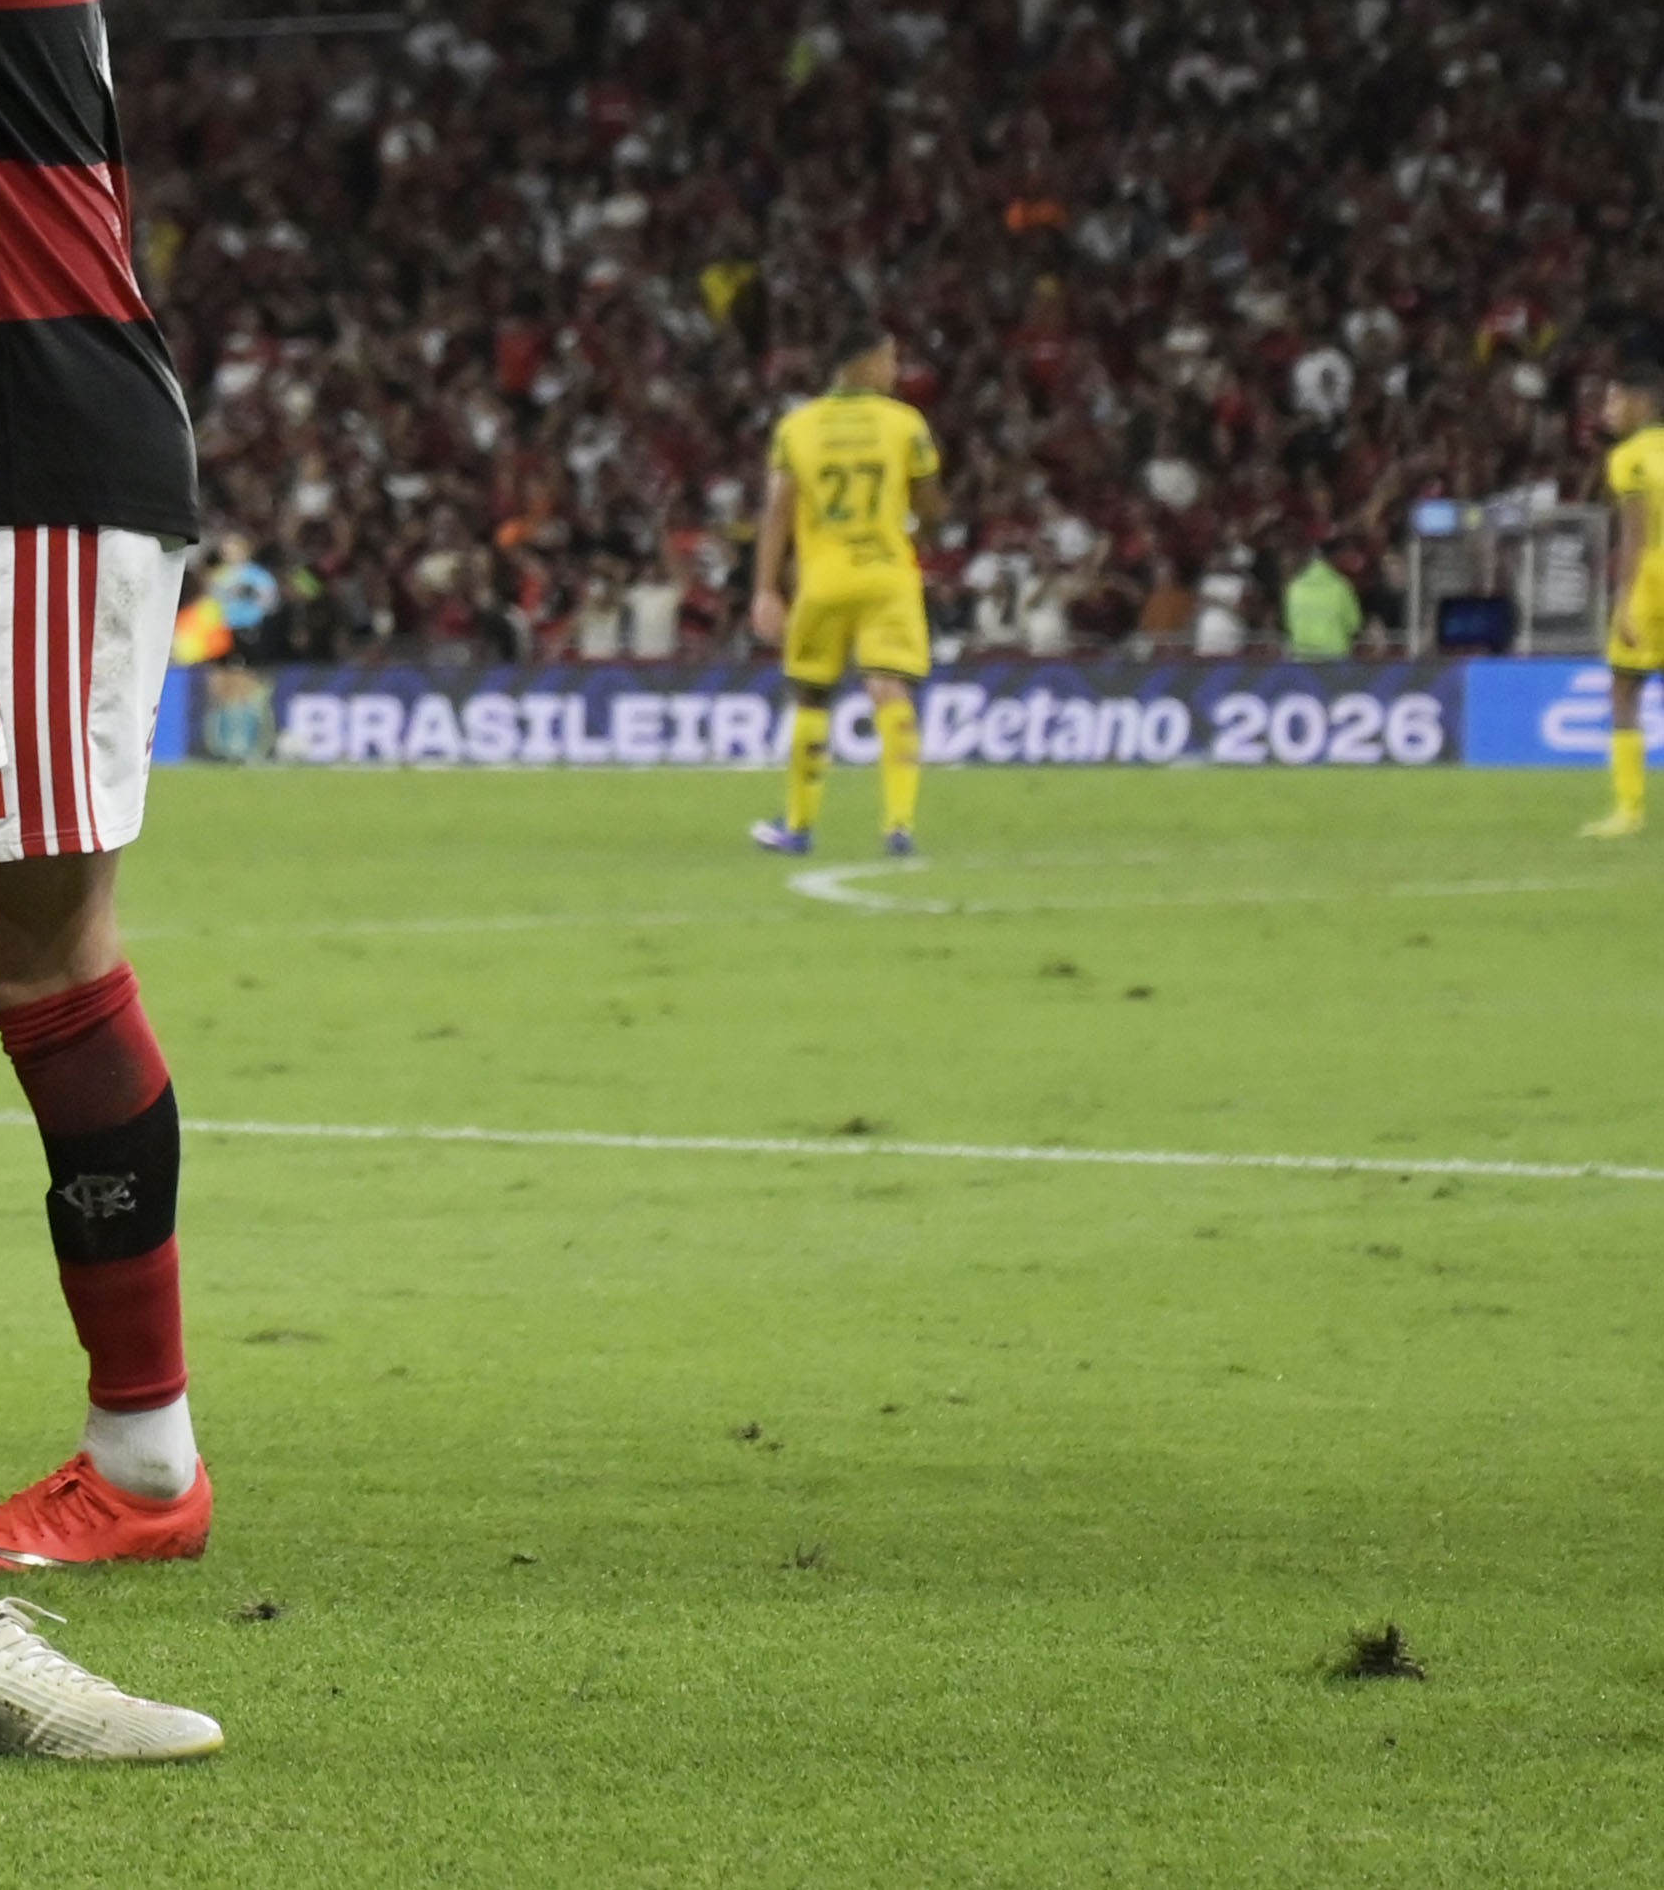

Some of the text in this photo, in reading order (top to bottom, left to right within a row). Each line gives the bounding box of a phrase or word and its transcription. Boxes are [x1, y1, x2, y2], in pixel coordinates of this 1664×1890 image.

[819, 462, 886, 521] 27
[286, 682, 1444, 766] BRASILEIRO Betano 2026
